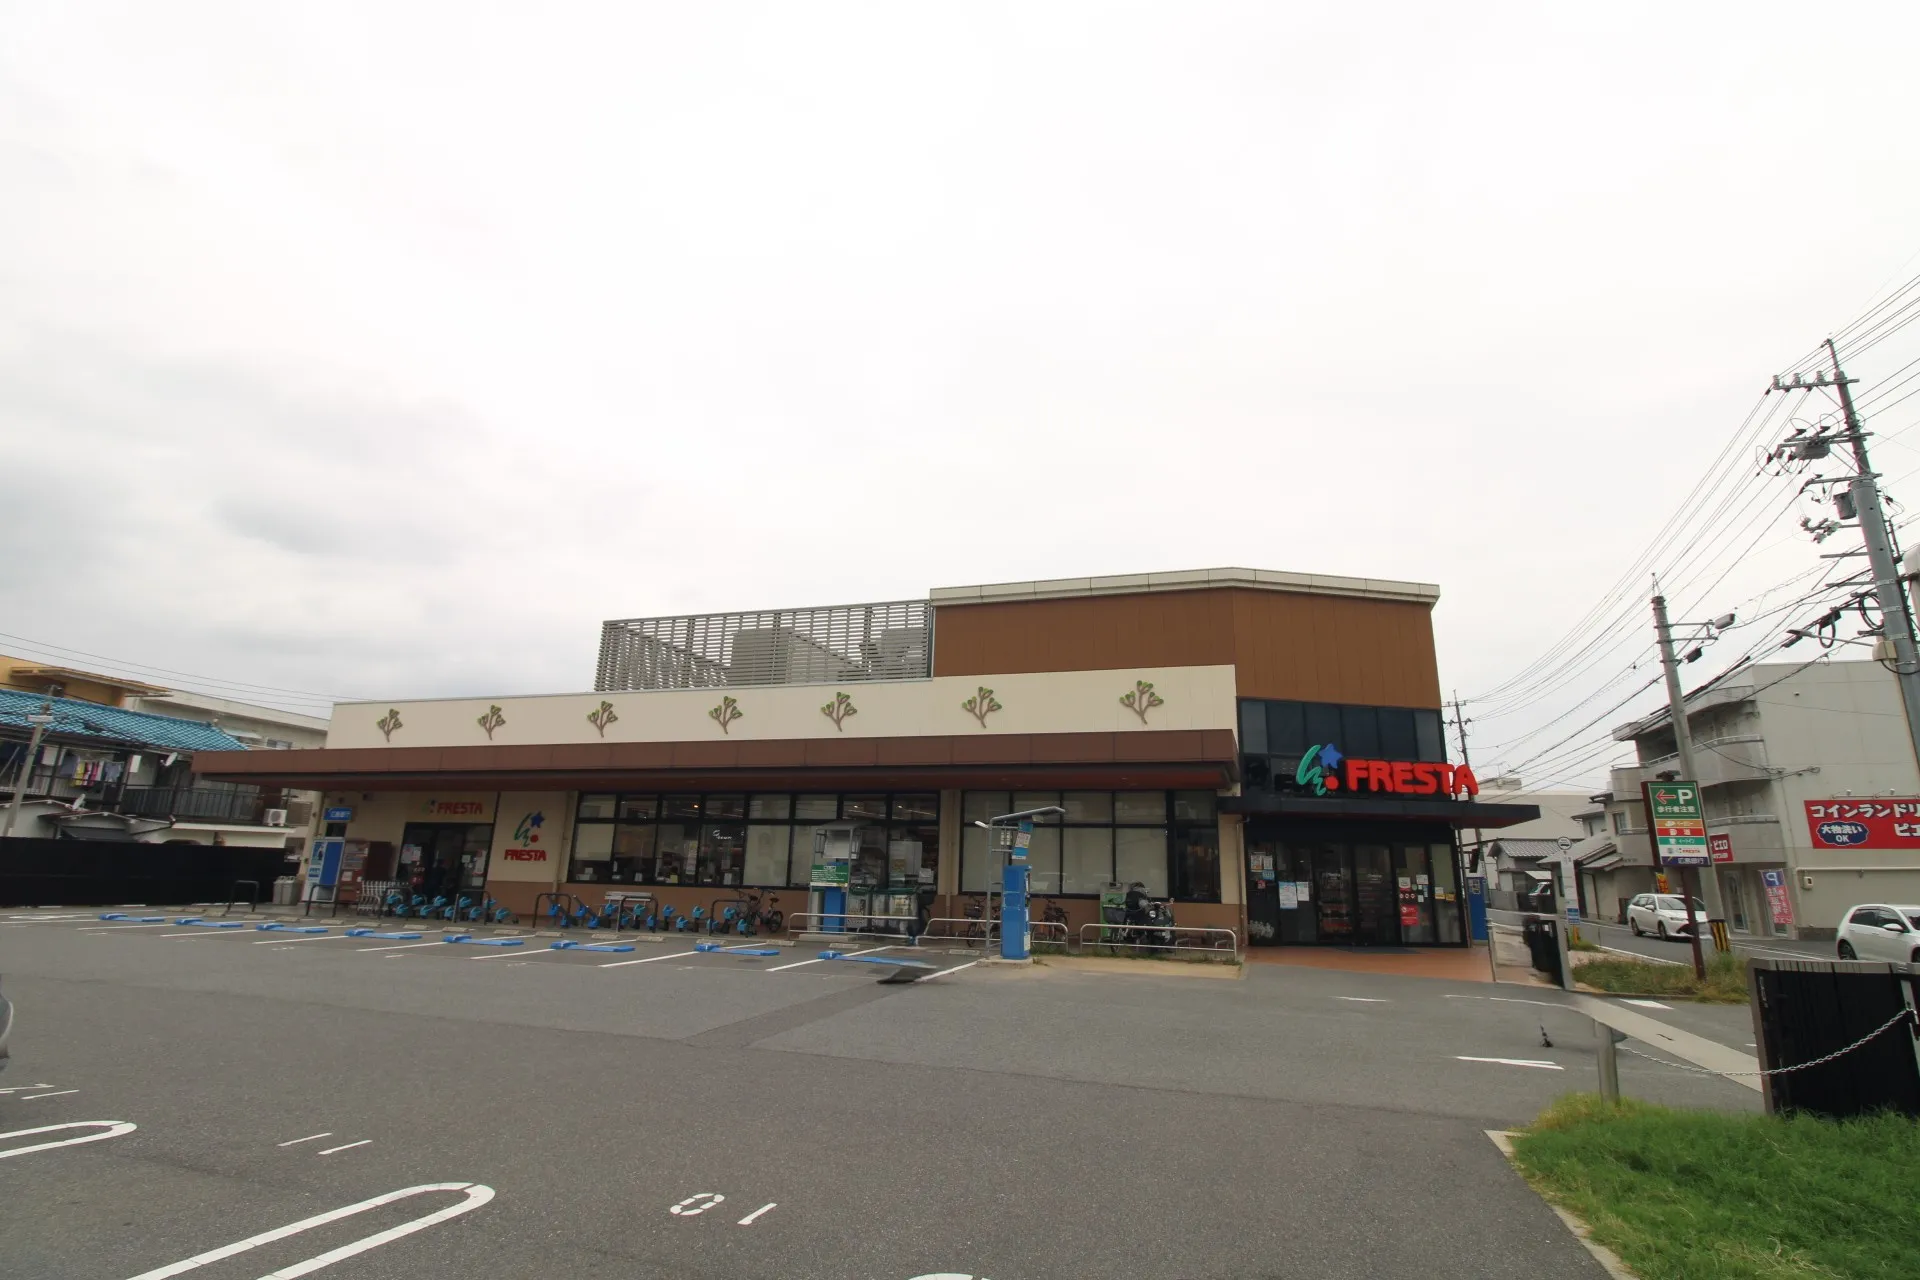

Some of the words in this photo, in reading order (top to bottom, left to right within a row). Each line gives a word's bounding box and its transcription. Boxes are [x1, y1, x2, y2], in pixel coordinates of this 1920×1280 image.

[1345, 759, 1480, 796] FRESTA
[1677, 789, 1693, 804] P
[437, 801, 483, 815] FRESTA
[1657, 805, 1696, 813] 歩行者注意
[1821, 824, 1863, 834] 大物洗い
[1835, 834, 1850, 843] OK
[504, 849, 547, 861] FRESTA
